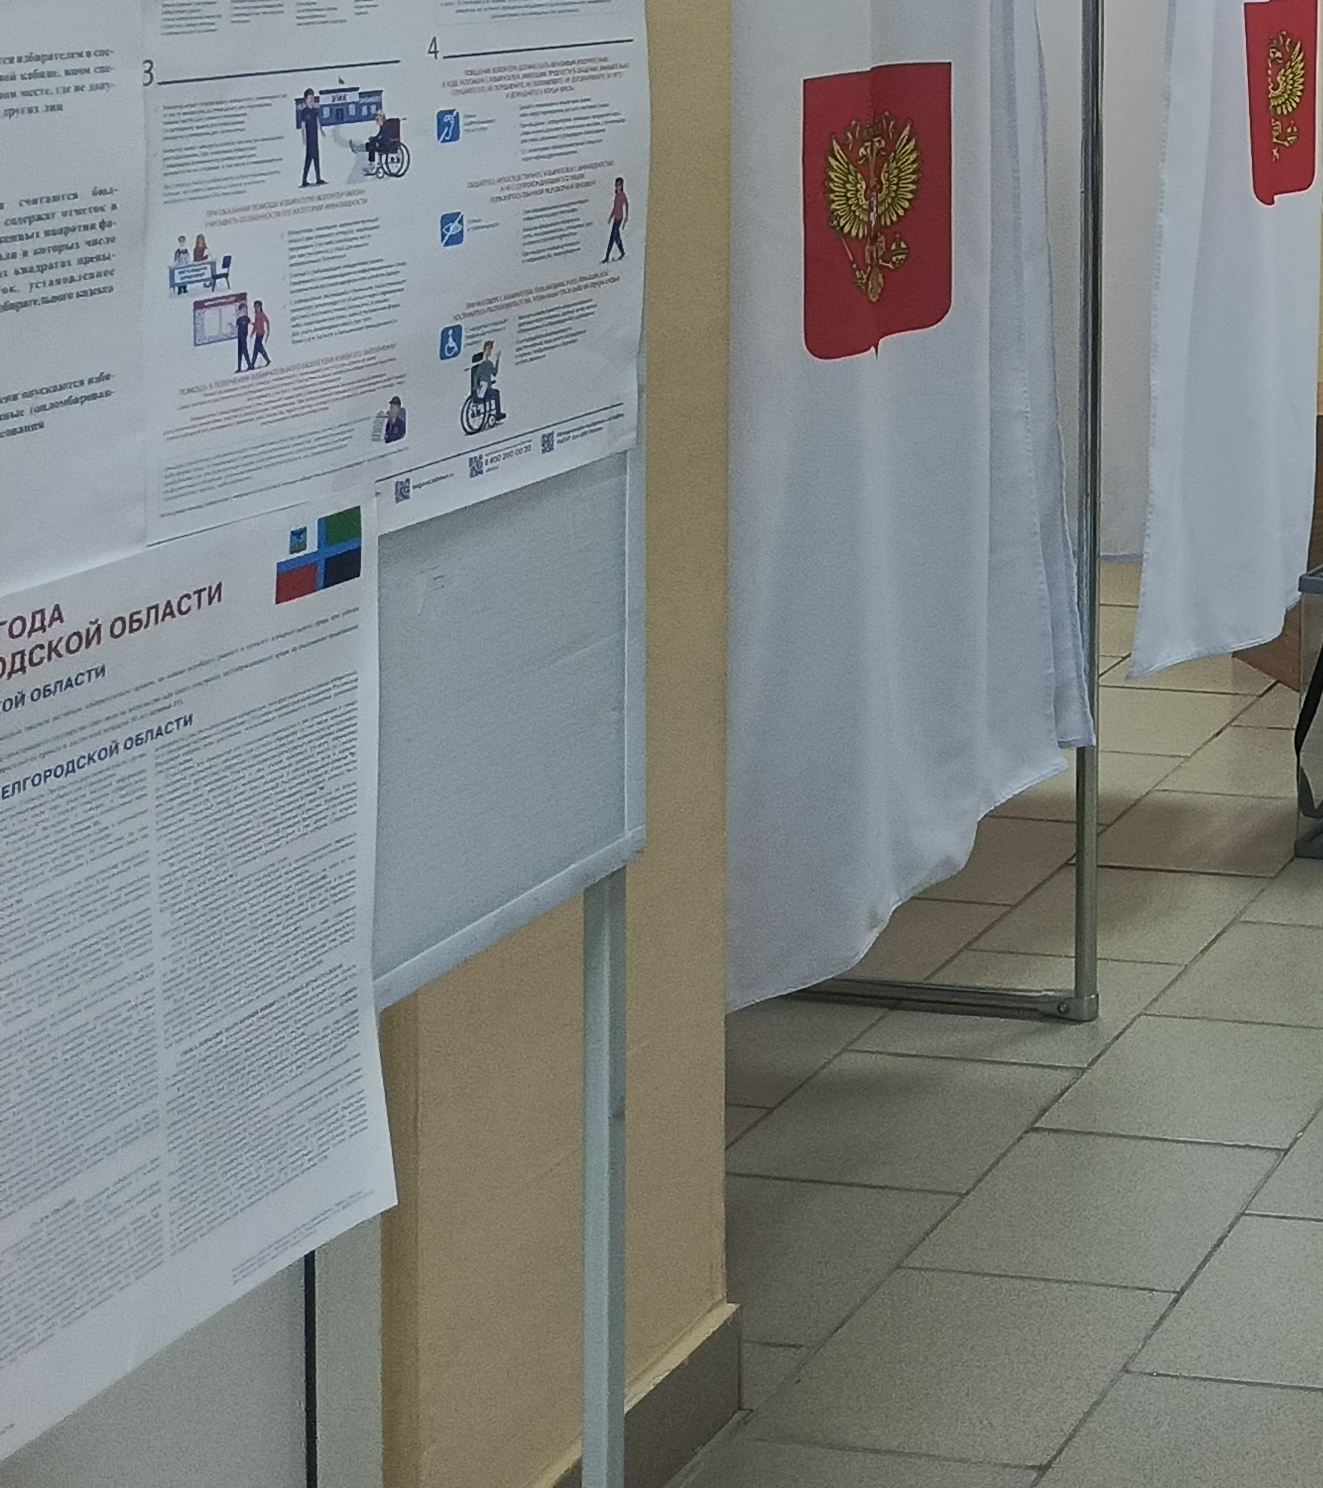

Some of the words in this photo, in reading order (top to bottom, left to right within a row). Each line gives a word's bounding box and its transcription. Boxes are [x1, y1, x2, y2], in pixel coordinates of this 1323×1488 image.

[142, 59, 154, 87] 3
[427, 36, 440, 60] 4
[109, 582, 223, 640] ОБЛАСТИ
[0, 690, 27, 714] ОЙ
[30, 664, 106, 703] ОБЛАСТИ
[1, 739, 120, 801] ЕЛГОРОДСКОЙ
[123, 713, 194, 751] ОБЛАСТИ
